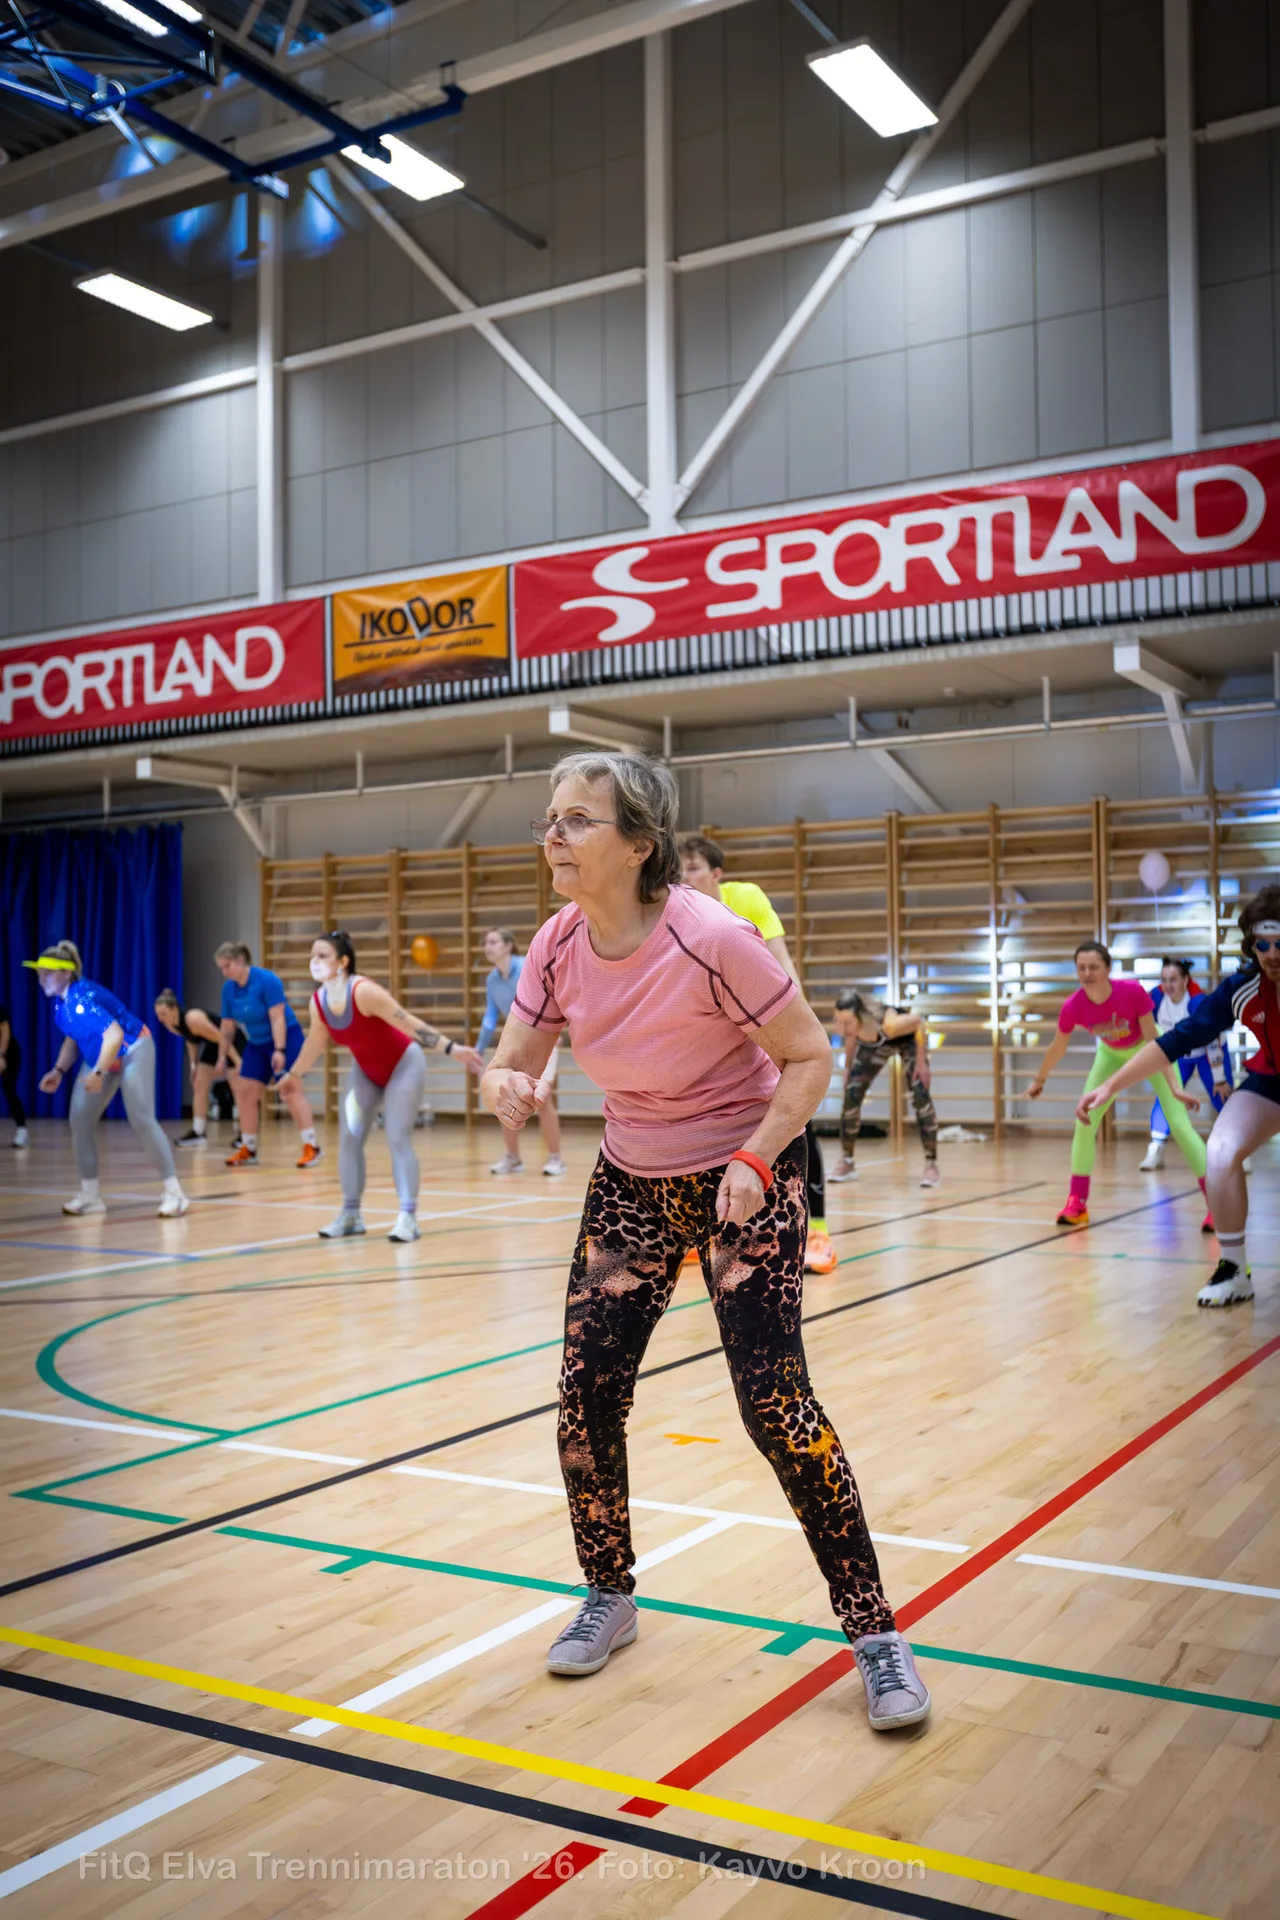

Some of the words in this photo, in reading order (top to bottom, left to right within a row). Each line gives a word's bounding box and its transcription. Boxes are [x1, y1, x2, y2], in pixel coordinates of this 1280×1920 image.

[704, 463, 1267, 619] SPORTLAND
[360, 596, 476, 640] IKODOR
[0, 625, 286, 724] PORTLAND
